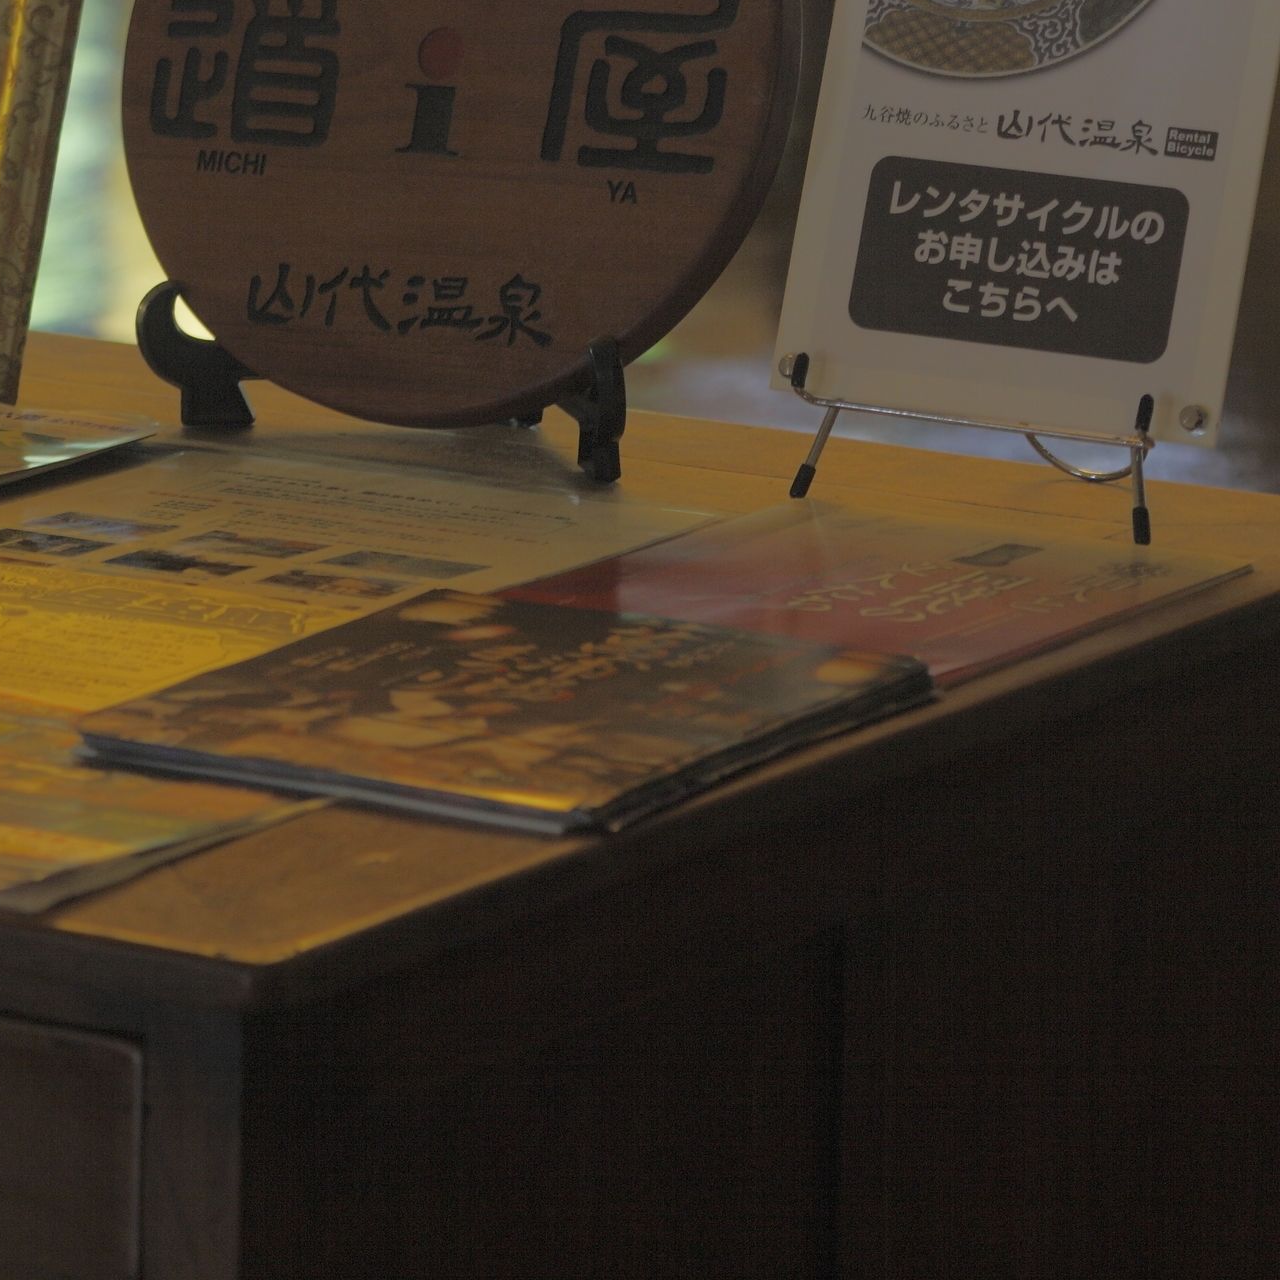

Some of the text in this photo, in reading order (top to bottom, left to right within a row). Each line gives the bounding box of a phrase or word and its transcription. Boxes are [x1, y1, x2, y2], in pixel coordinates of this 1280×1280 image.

[394, 26, 465, 158] i
[862, 103, 990, 134] 九谷焼のふるさと
[996, 109, 1160, 157] 山代温泉
[1168, 128, 1212, 145] Rental
[196, 149, 267, 177] MICHI
[1166, 140, 1215, 158] Bicycle
[606, 180, 638, 205] YA
[889, 180, 1166, 245] レンタサイクルの
[913, 228, 1123, 286] お申し込みは
[246, 262, 554, 348] 山代温泉
[941, 278, 1079, 323] こちらへ
